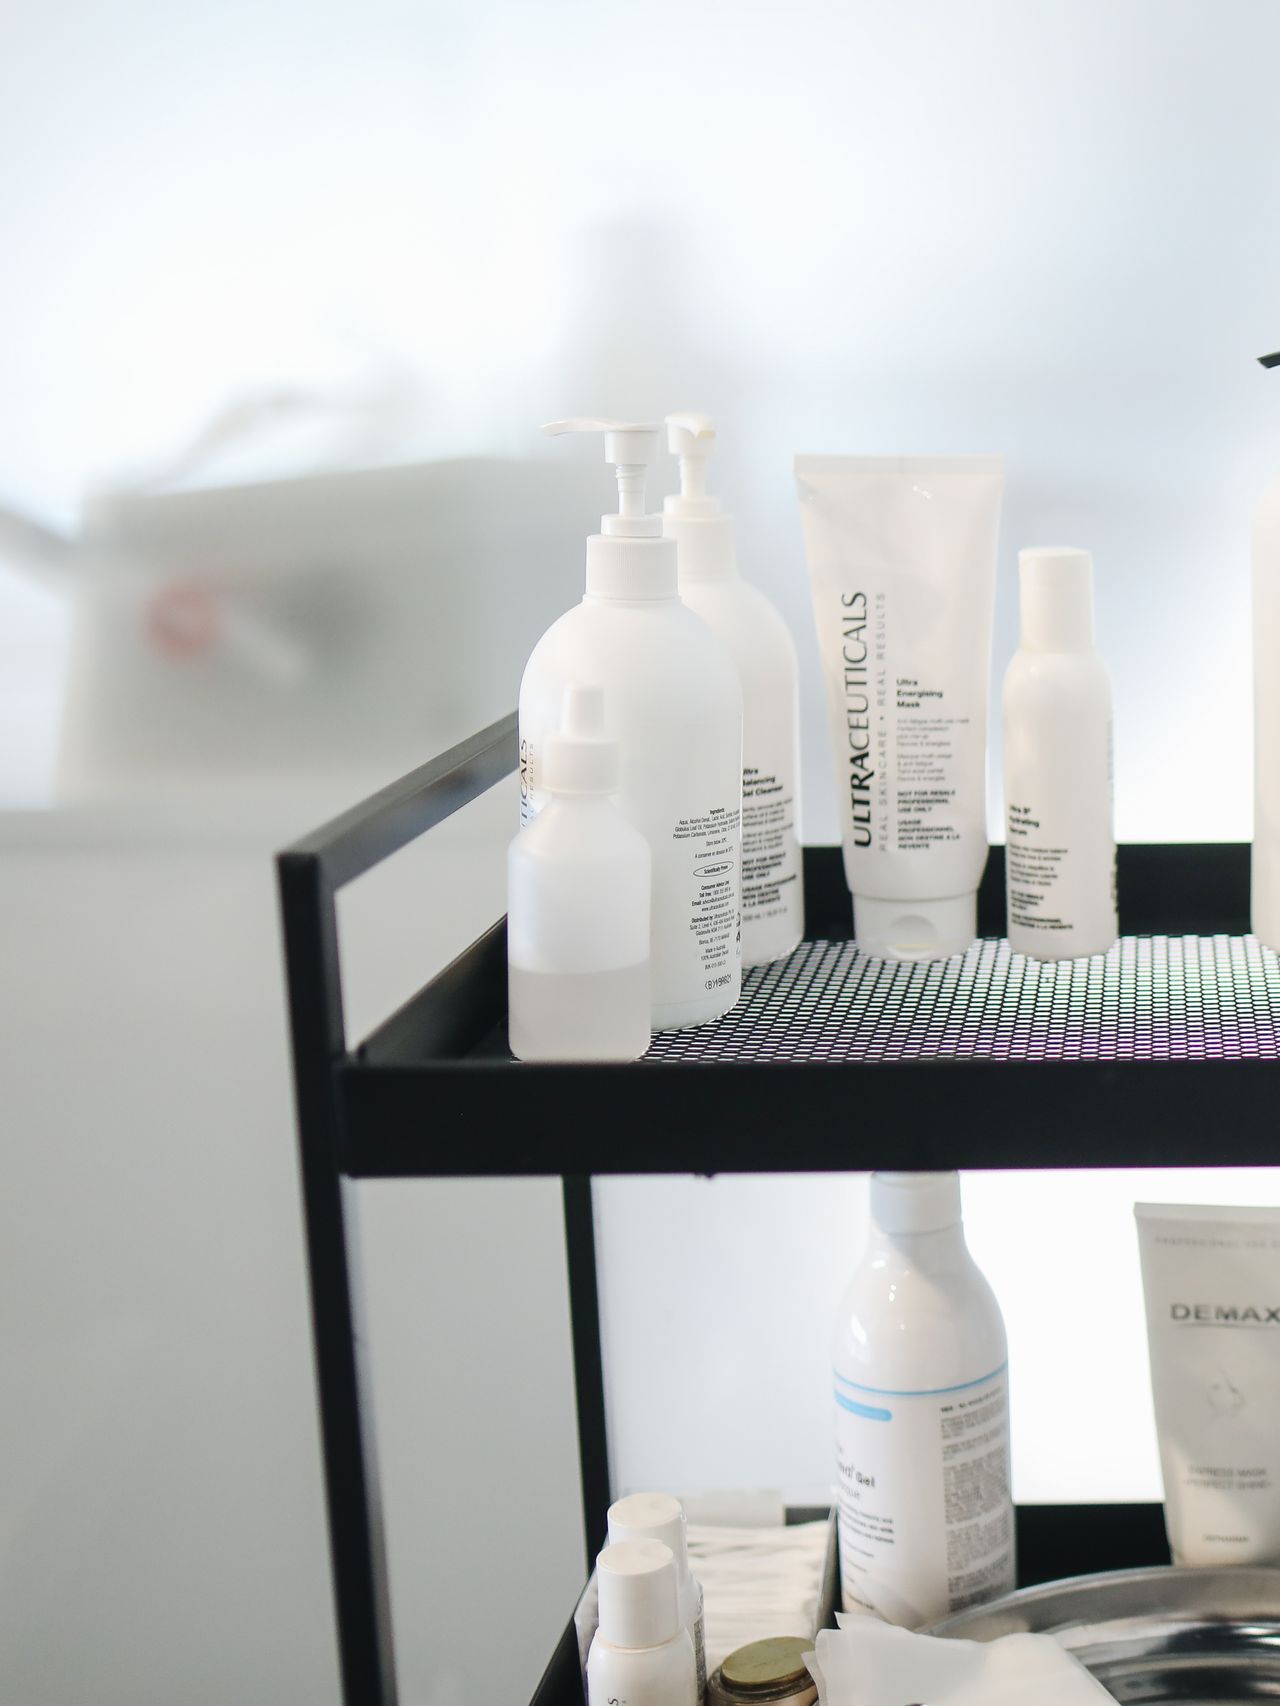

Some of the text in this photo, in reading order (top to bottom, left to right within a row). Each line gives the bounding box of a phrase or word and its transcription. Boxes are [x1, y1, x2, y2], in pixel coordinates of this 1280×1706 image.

[876, 592, 885, 660] RESULTS
[878, 669, 886, 706] REAL
[896, 690, 944, 698] Energising
[842, 592, 874, 848] ULTRACEUTICALS
[755, 786, 784, 796] Cleanser
[878, 730, 887, 806] SKINCARE
